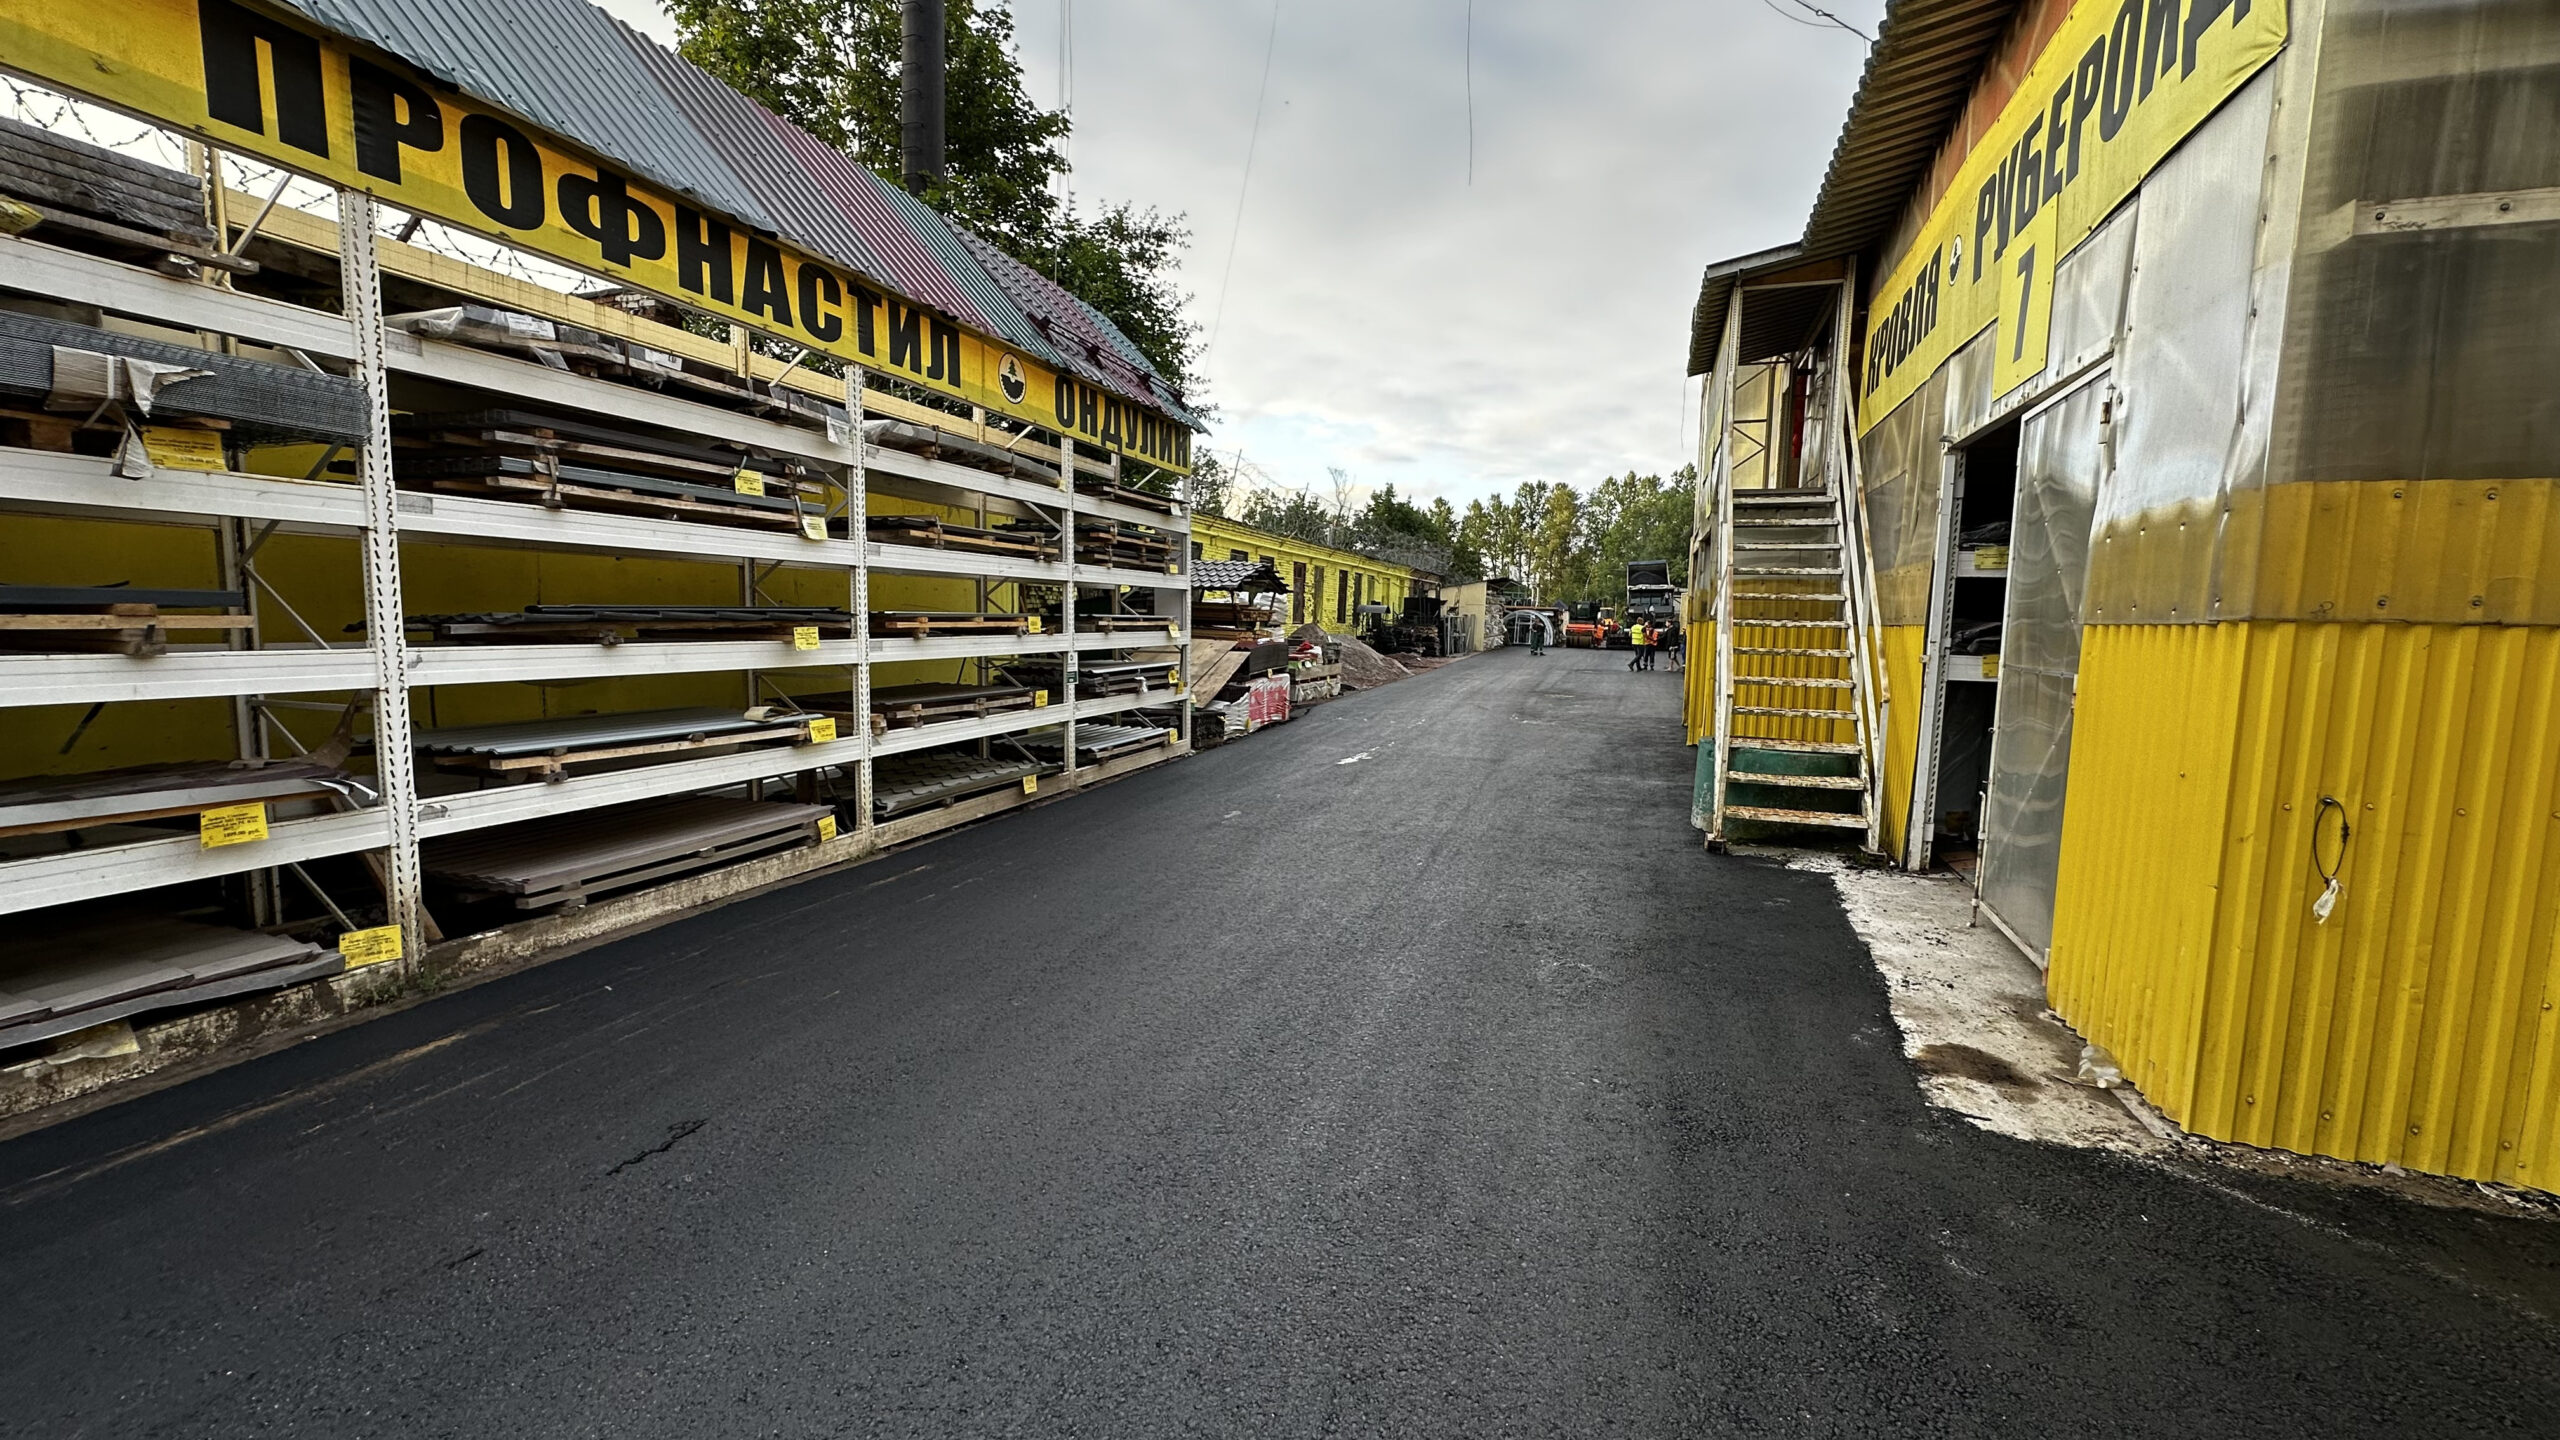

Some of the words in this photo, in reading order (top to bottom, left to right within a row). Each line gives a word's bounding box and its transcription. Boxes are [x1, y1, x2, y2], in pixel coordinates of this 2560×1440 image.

[197, 0, 962, 389] ПРОФНАСТИЛ
[1866, 241, 1943, 399] КРОВЛЯ
[2012, 243, 2036, 364] 7
[1054, 373, 1188, 469] ОНДУЛИН
